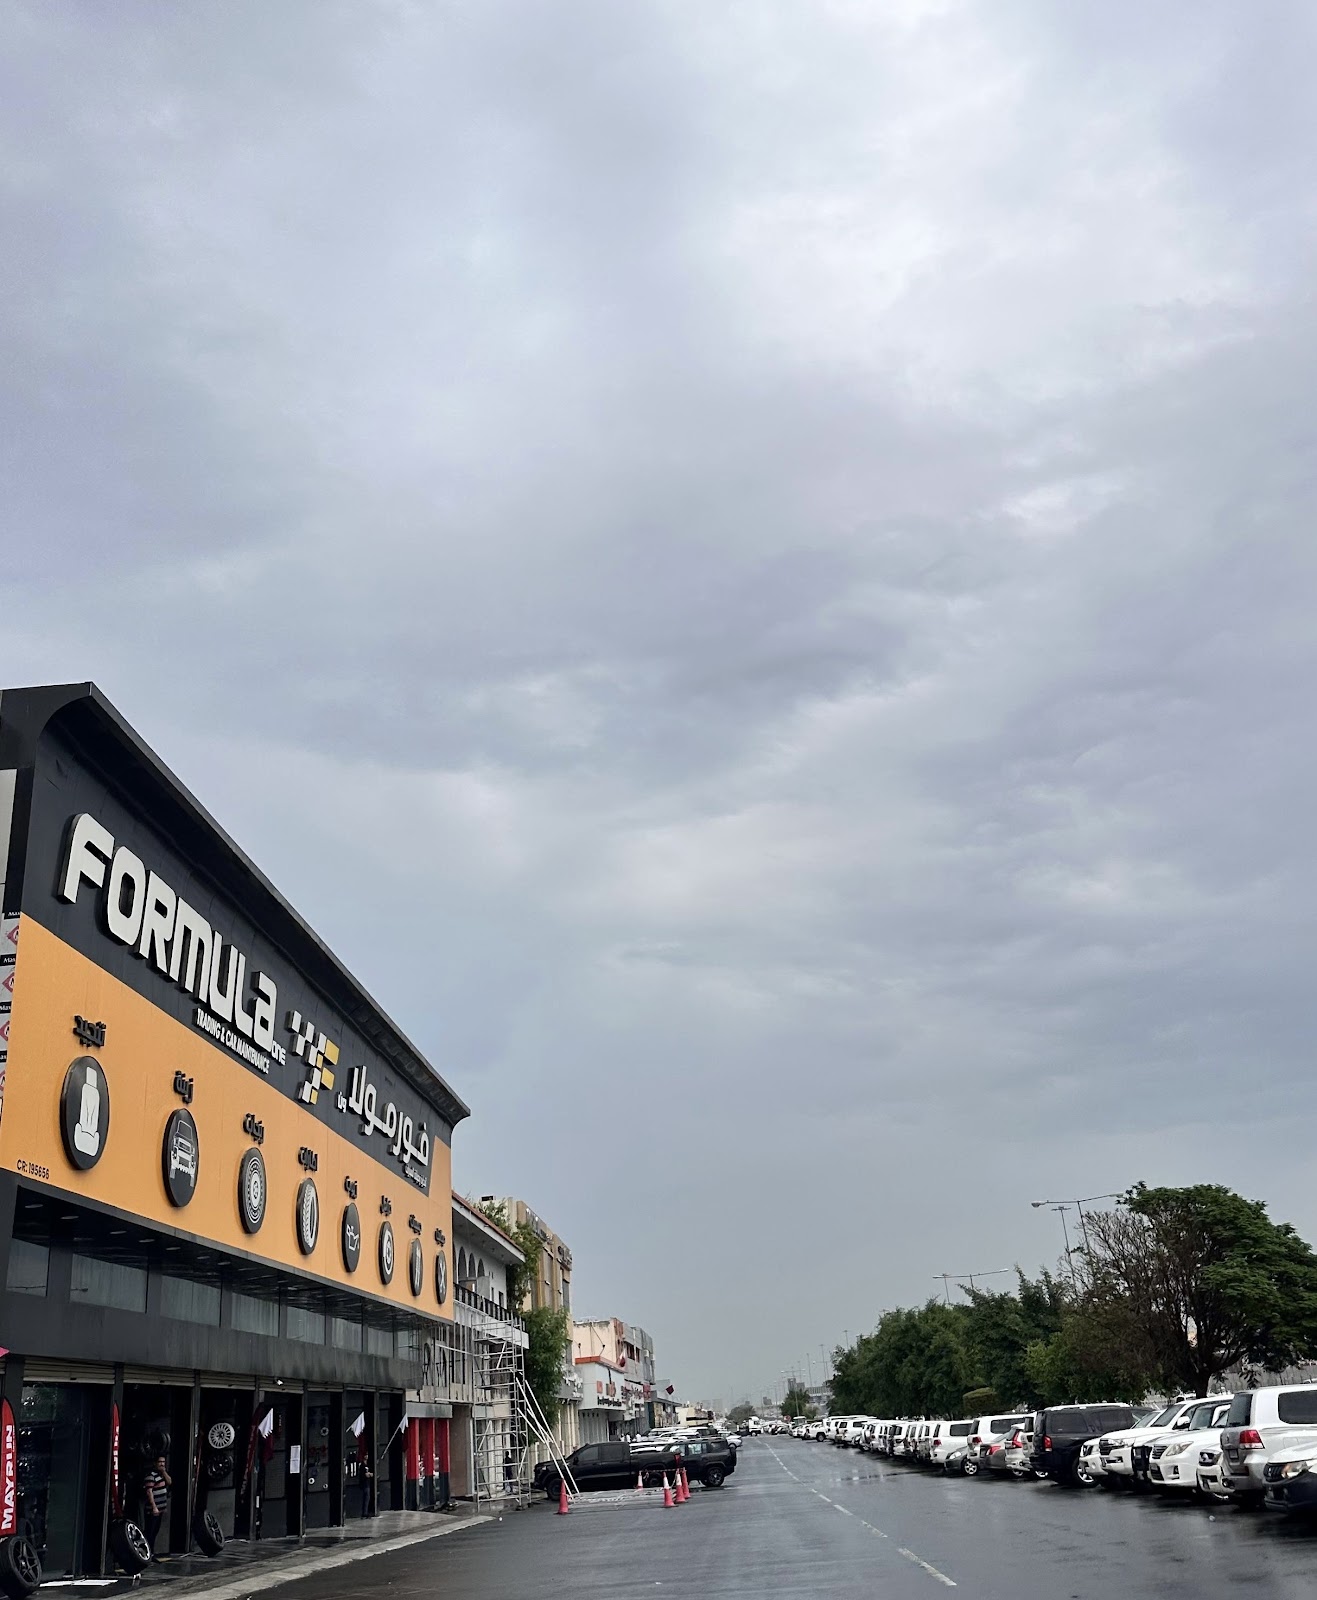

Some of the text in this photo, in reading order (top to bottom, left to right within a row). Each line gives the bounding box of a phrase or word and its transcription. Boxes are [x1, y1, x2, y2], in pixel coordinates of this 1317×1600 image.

[61, 812, 279, 1052] FORMULA
[196, 1007, 221, 1039] TRADING
[220, 1027, 225, 1043] &
[225, 1030, 237, 1051] CAR
[348, 1065, 430, 1167] فورمولا
